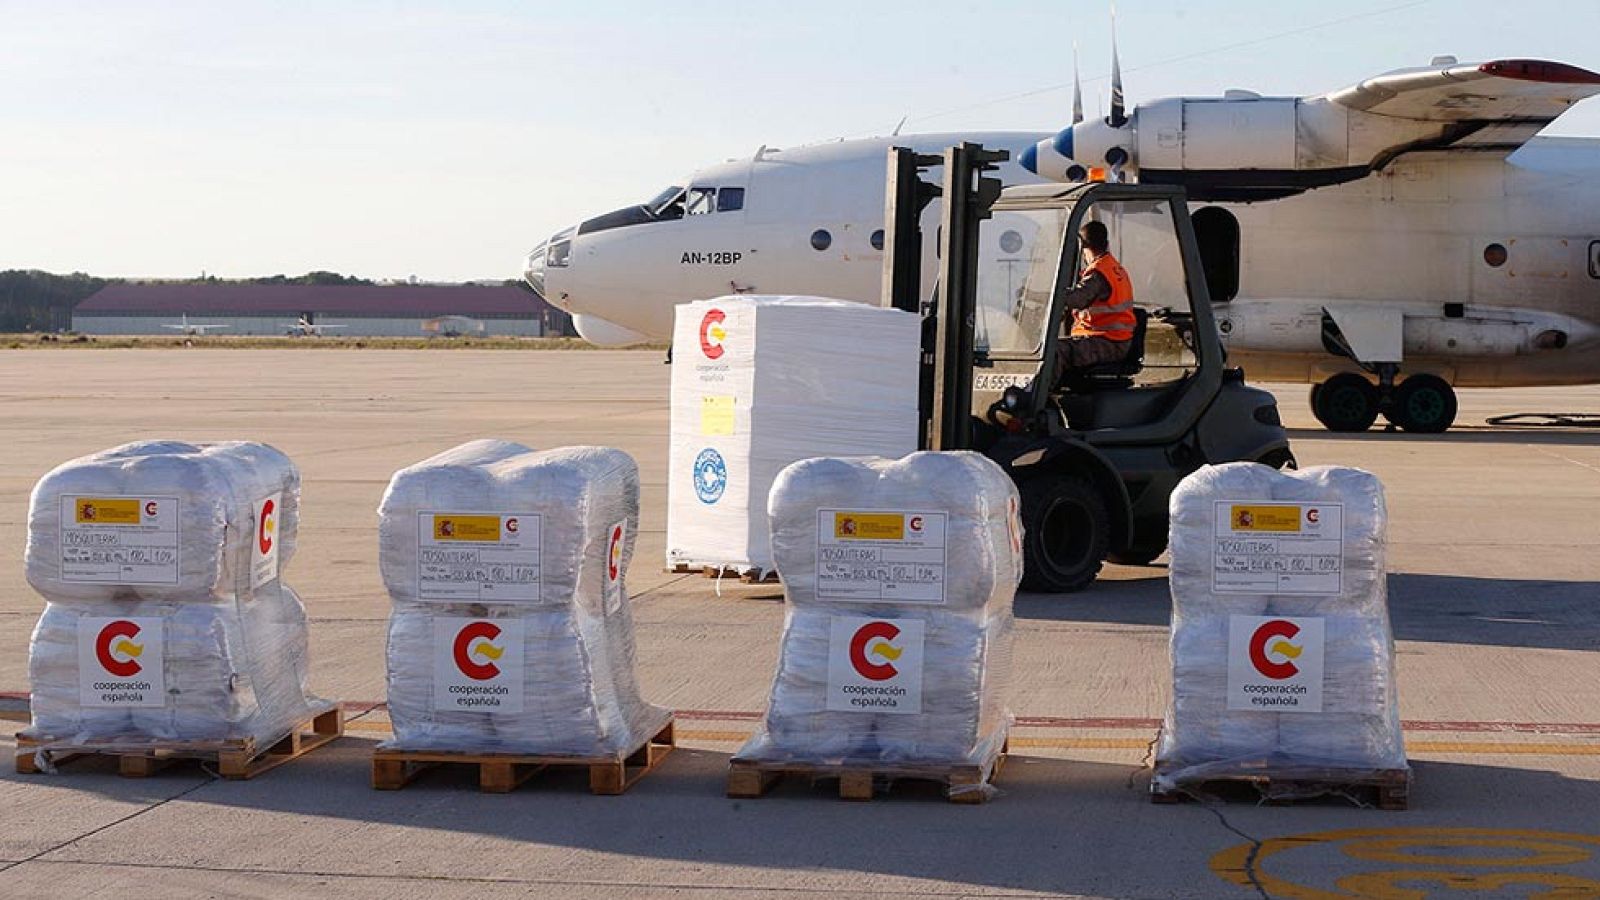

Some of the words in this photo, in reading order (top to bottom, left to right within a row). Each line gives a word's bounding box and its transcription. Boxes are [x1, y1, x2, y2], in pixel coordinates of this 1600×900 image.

[681, 252, 742, 264] AN-12BP
[93, 681, 151, 691] cooperación
[449, 684, 509, 695] cooperación
[843, 685, 906, 696] cooperación
[1243, 684, 1307, 695] cooperación
[102, 692, 143, 702] española
[457, 696, 501, 707] española
[851, 697, 897, 707] española
[1251, 695, 1299, 706] española
